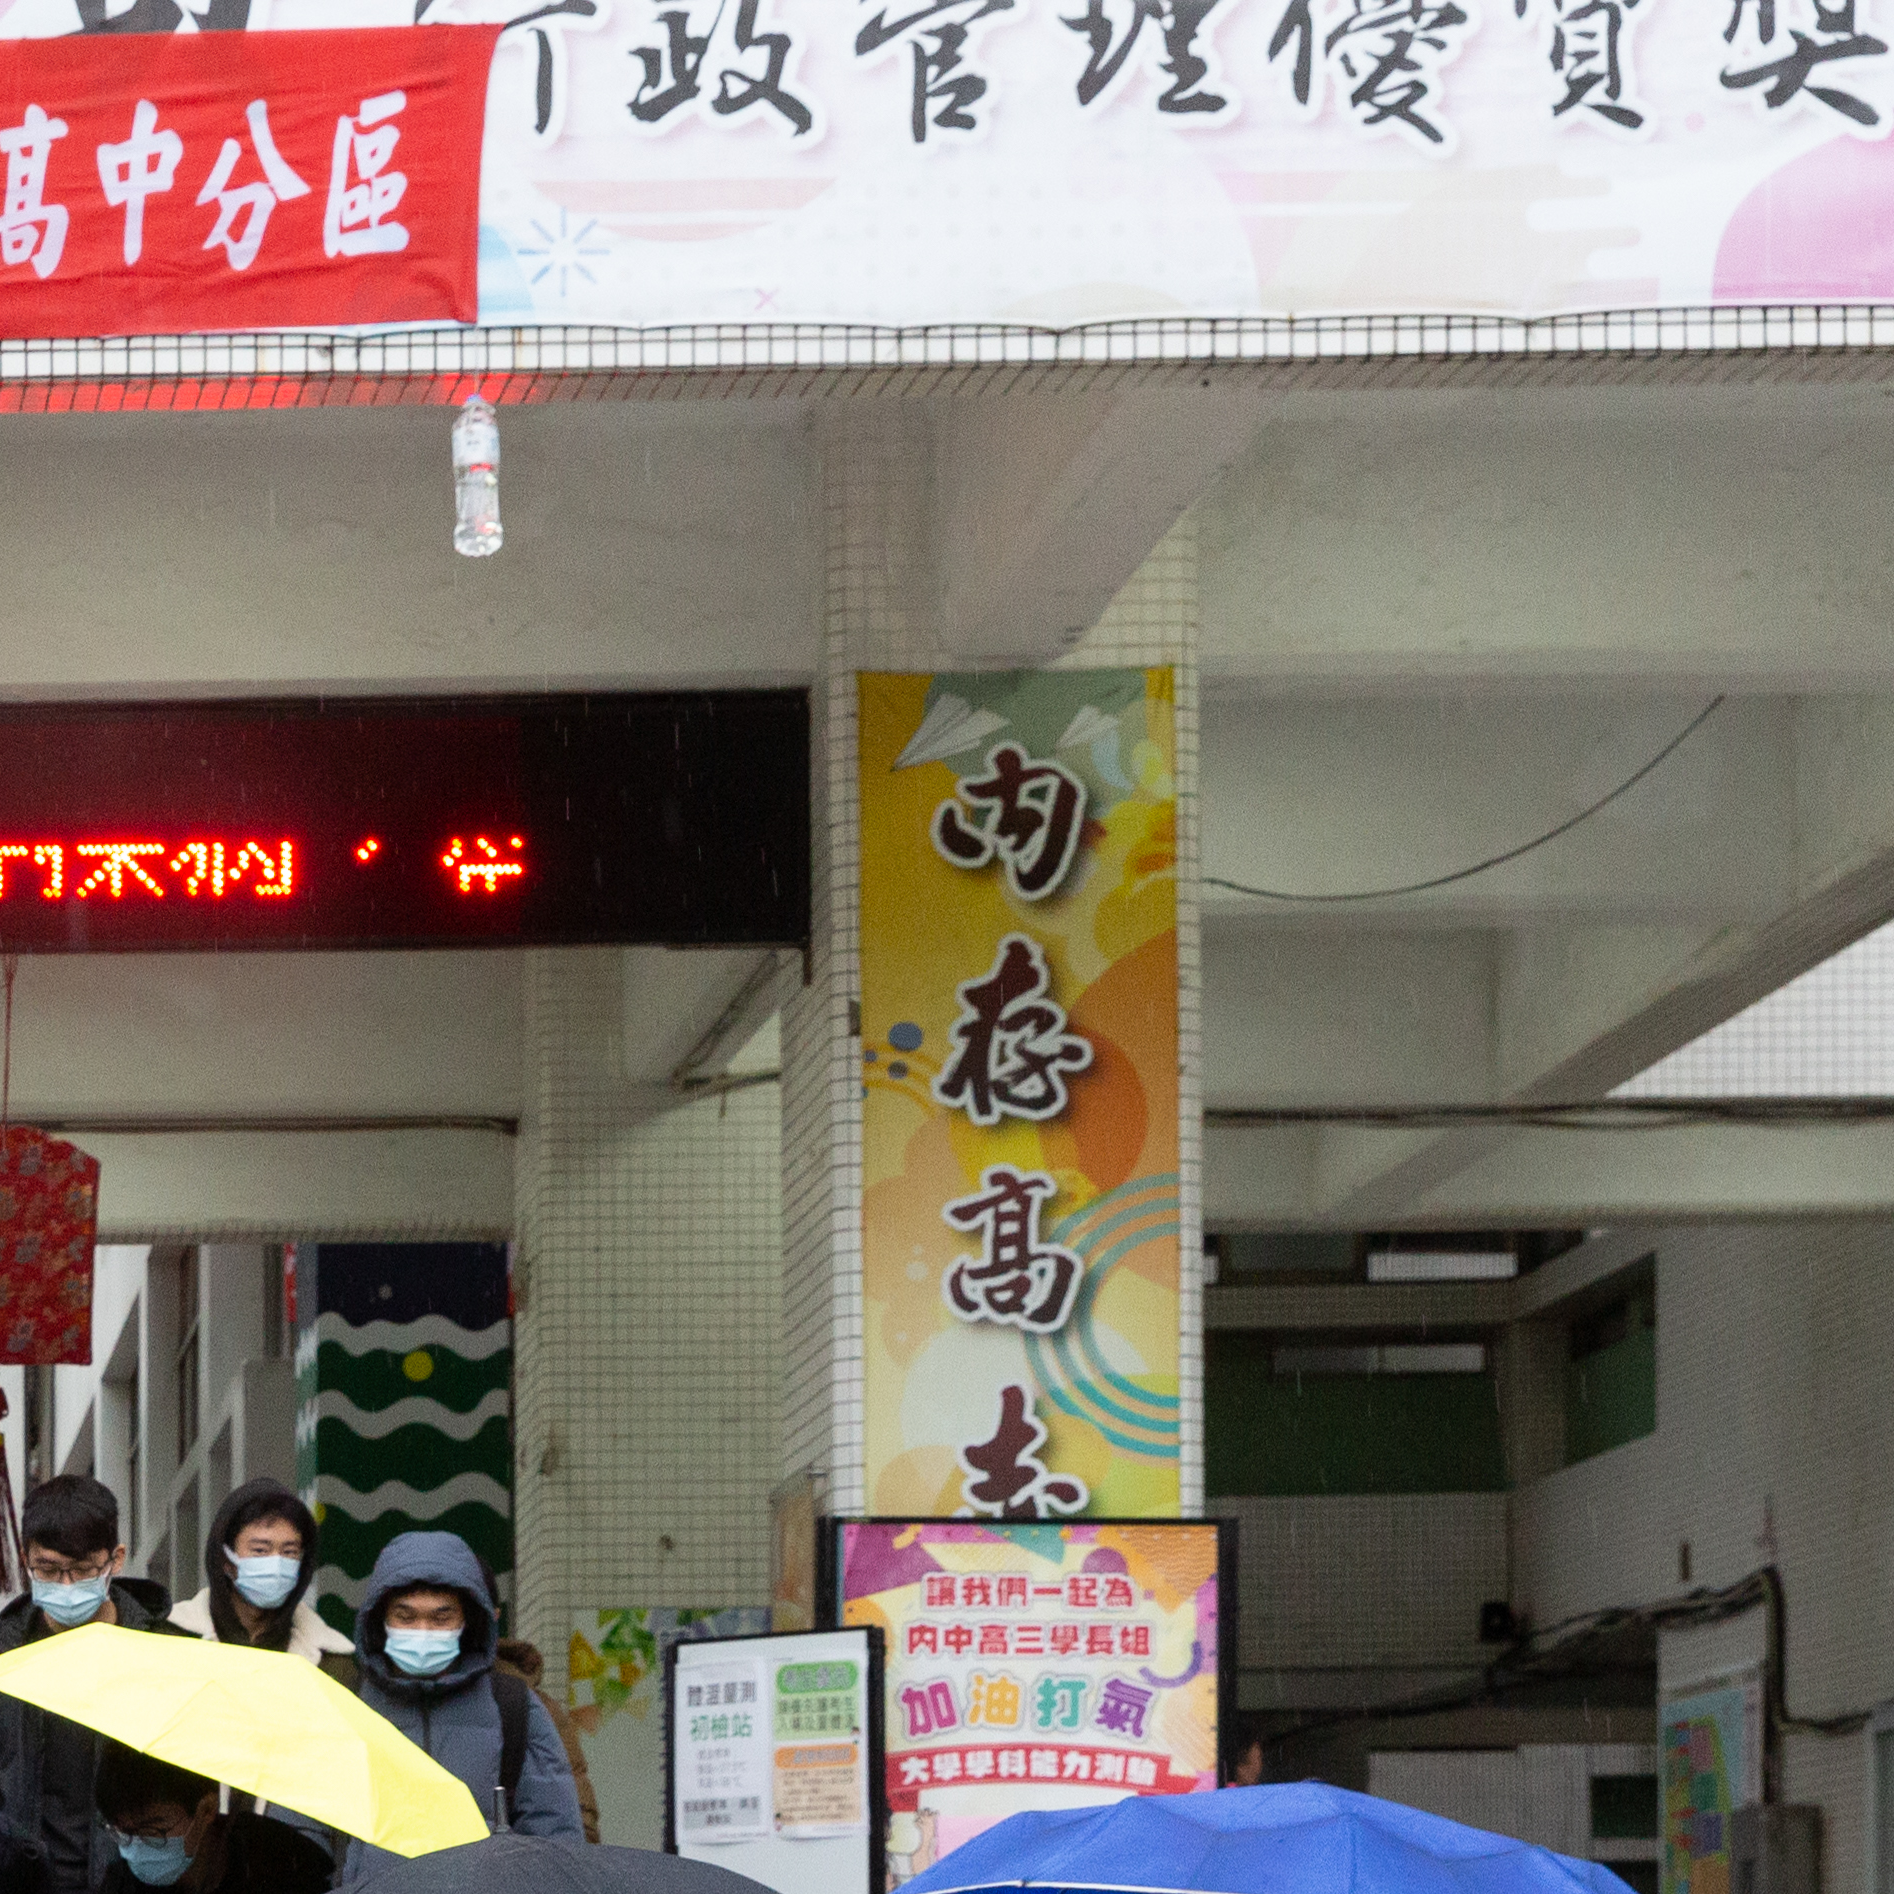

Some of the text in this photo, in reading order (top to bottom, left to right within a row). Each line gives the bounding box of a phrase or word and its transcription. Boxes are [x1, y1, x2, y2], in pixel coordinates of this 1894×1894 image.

[925, 1575, 1134, 1608] 讓我們一起為
[900, 1673, 1155, 1739] 加油打氣
[898, 1748, 1159, 1788] 大學學科能力測驗
